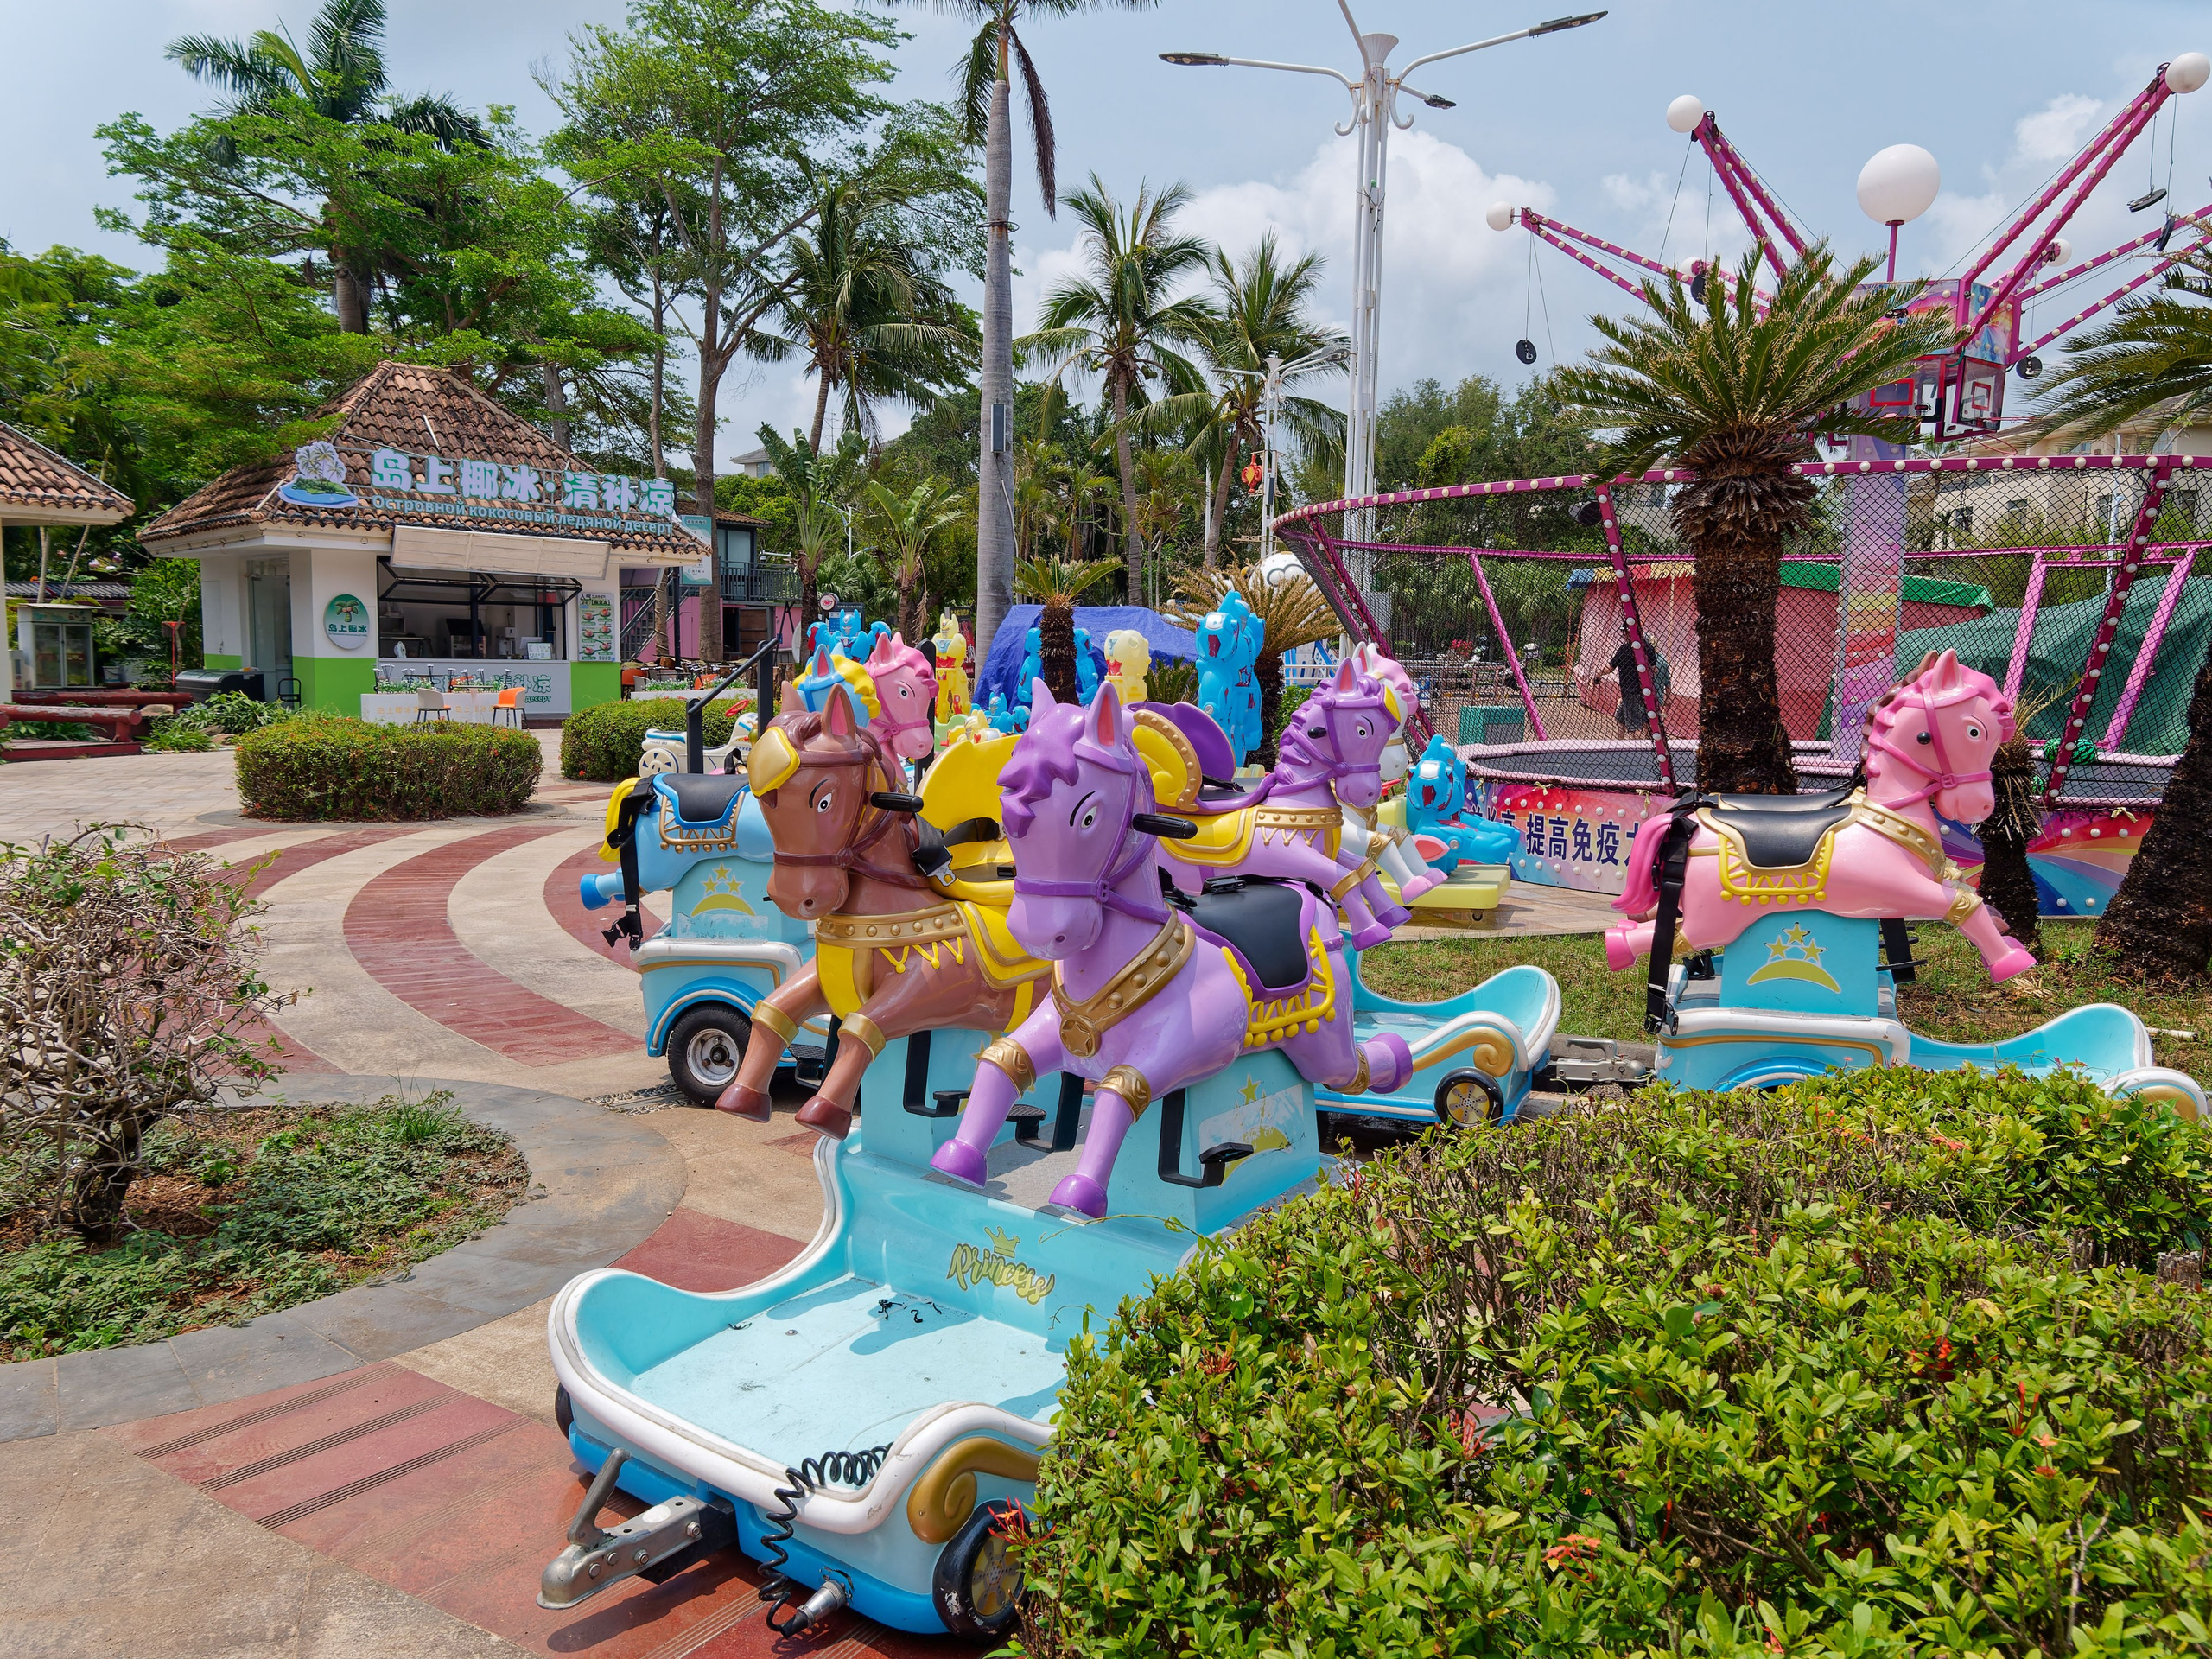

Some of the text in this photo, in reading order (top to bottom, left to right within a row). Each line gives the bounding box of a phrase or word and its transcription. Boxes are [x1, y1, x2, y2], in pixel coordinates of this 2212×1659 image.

[372, 495, 673, 537] Островной кокосовый ледяной десерт
[947, 1243, 1055, 1305] Princess
